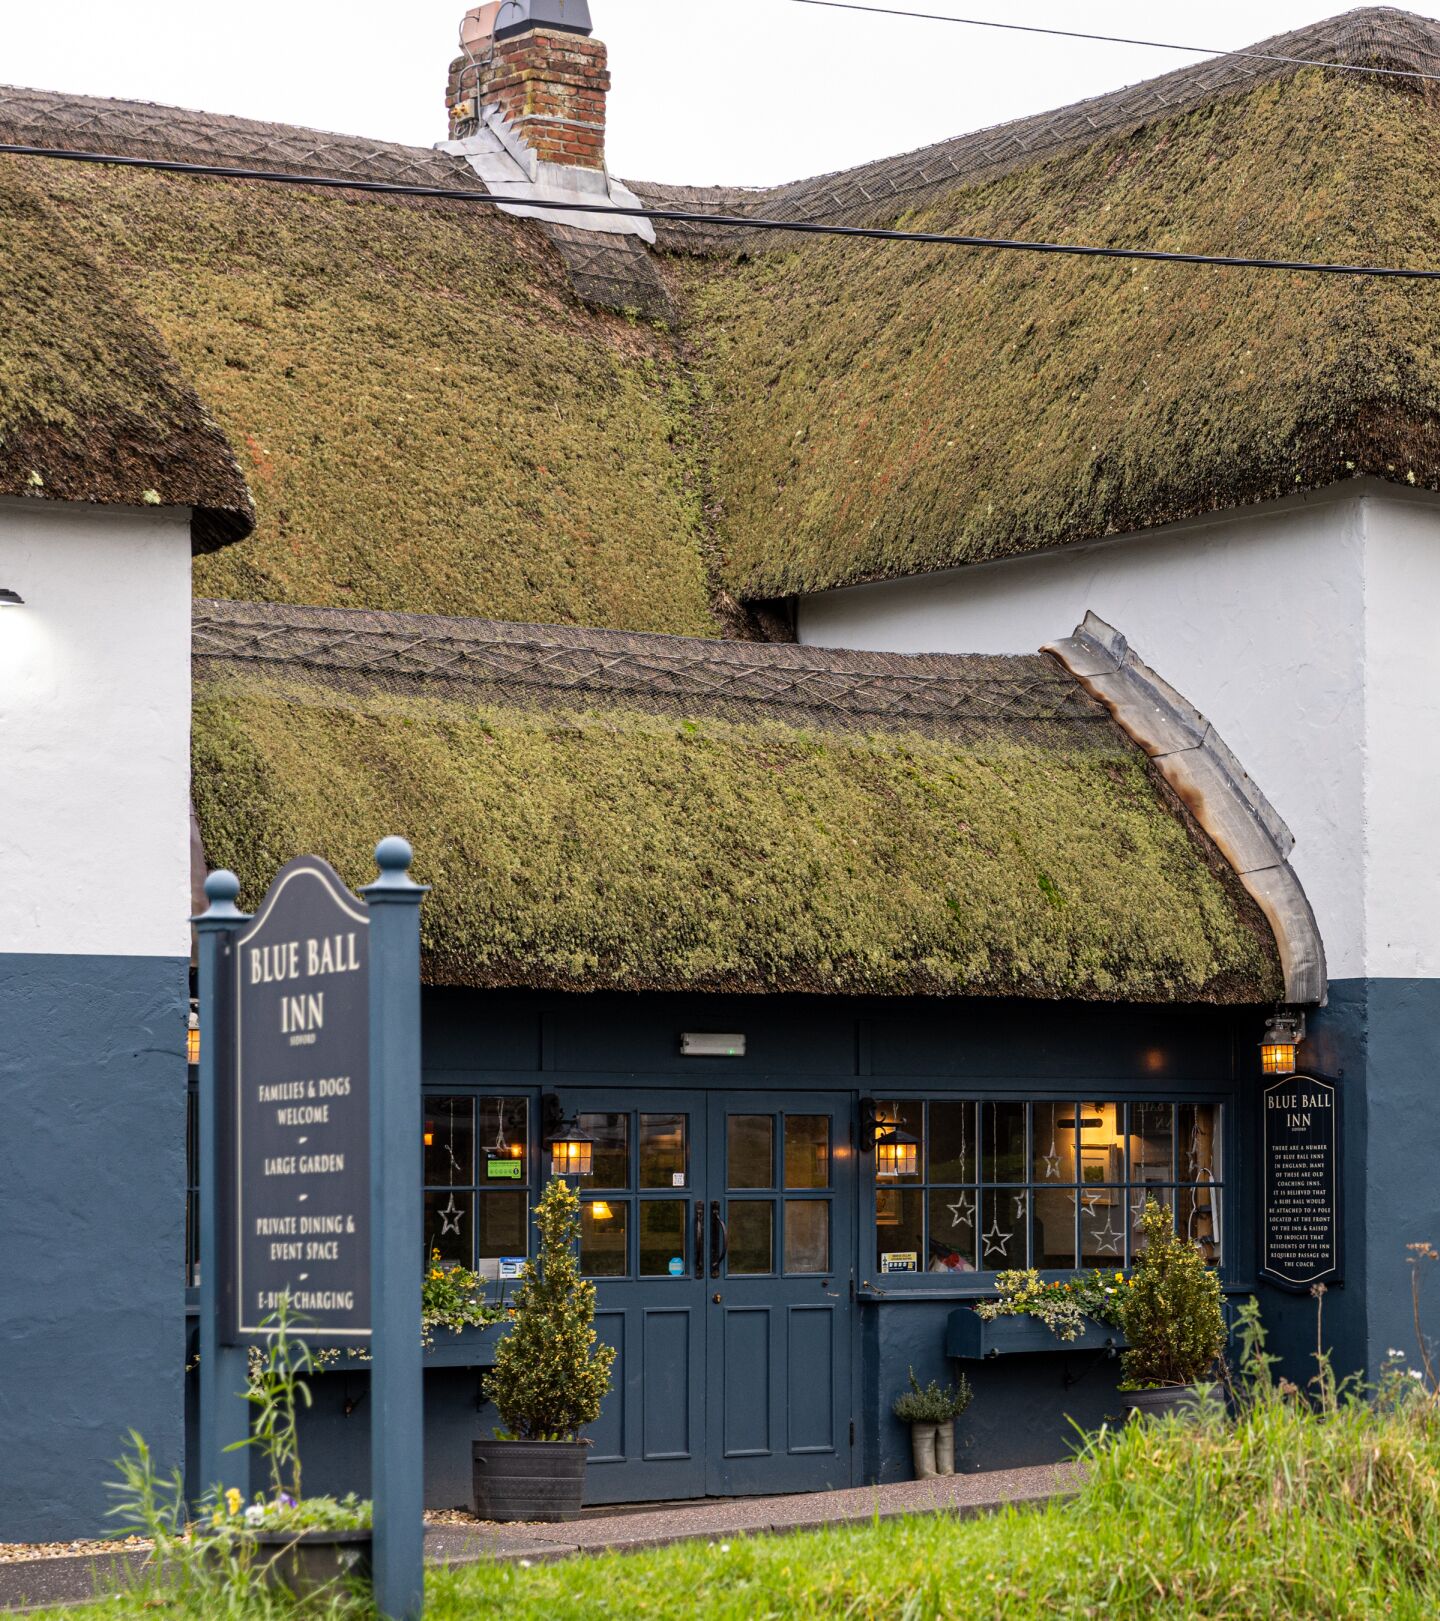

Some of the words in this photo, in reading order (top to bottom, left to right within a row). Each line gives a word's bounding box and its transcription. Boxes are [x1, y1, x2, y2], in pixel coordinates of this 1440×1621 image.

[251, 943, 299, 985] BLUE
[307, 933, 360, 977] BALL
[281, 992, 324, 1033] INN
[259, 1081, 305, 1102] FAMILIES
[307, 1080, 316, 1098] &
[319, 1077, 351, 1098] DOGS
[1268, 1095, 1297, 1109] BLUE
[1302, 1094, 1331, 1107] BALL
[277, 1104, 329, 1125] WELCOME
[1288, 1113, 1310, 1127] INN
[264, 1156, 296, 1176] LARGE
[299, 1153, 344, 1173] GARDEN
[256, 1217, 297, 1236] PRIVATE
[300, 1216, 343, 1234] DINING
[345, 1215, 355, 1233] &
[270, 1243, 303, 1261] EVENT
[306, 1242, 338, 1260] SPACE
[294, 1291, 354, 1310] CHARGING
